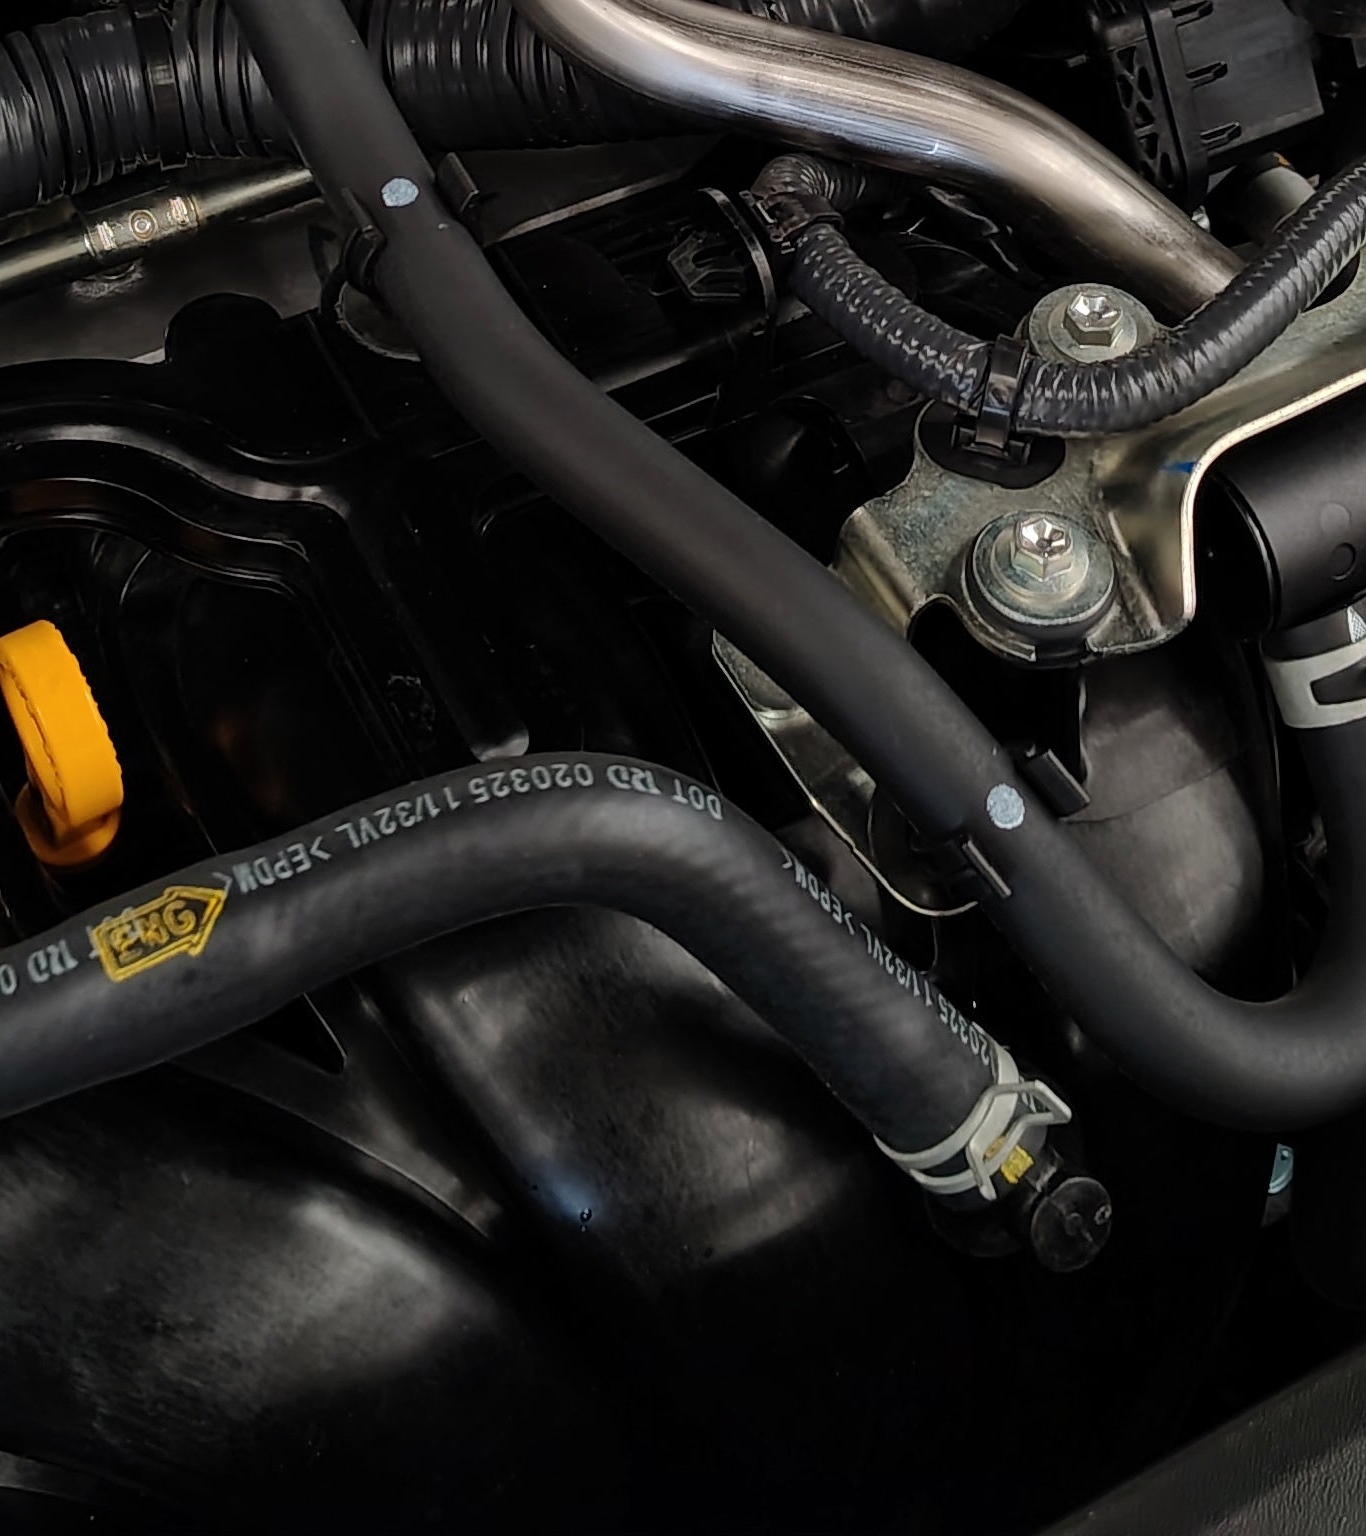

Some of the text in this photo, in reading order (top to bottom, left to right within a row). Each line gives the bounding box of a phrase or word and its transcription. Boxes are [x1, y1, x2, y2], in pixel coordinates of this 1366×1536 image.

[468, 762, 596, 805] 020325
[672, 777, 725, 821] DOT
[937, 993, 992, 1066] 20325
